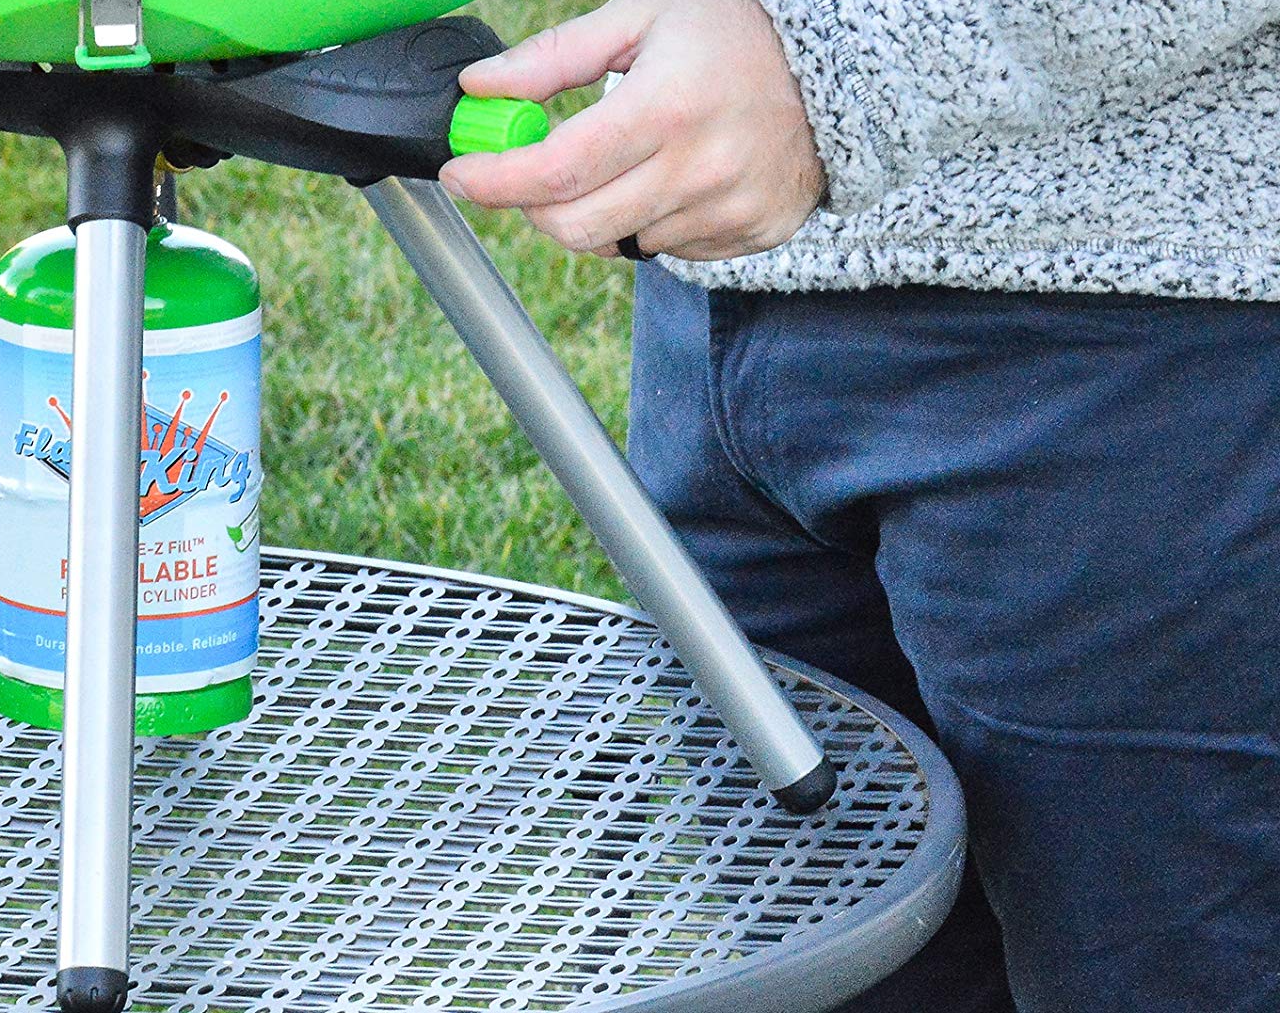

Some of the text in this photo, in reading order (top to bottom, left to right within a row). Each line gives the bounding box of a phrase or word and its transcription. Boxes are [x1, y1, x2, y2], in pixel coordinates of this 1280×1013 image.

[14, 422, 251, 504] Fla King
[143, 584, 217, 604] CYLINDER
[35, 635, 66, 652] Dura
[136, 641, 188, 655] ndable.
